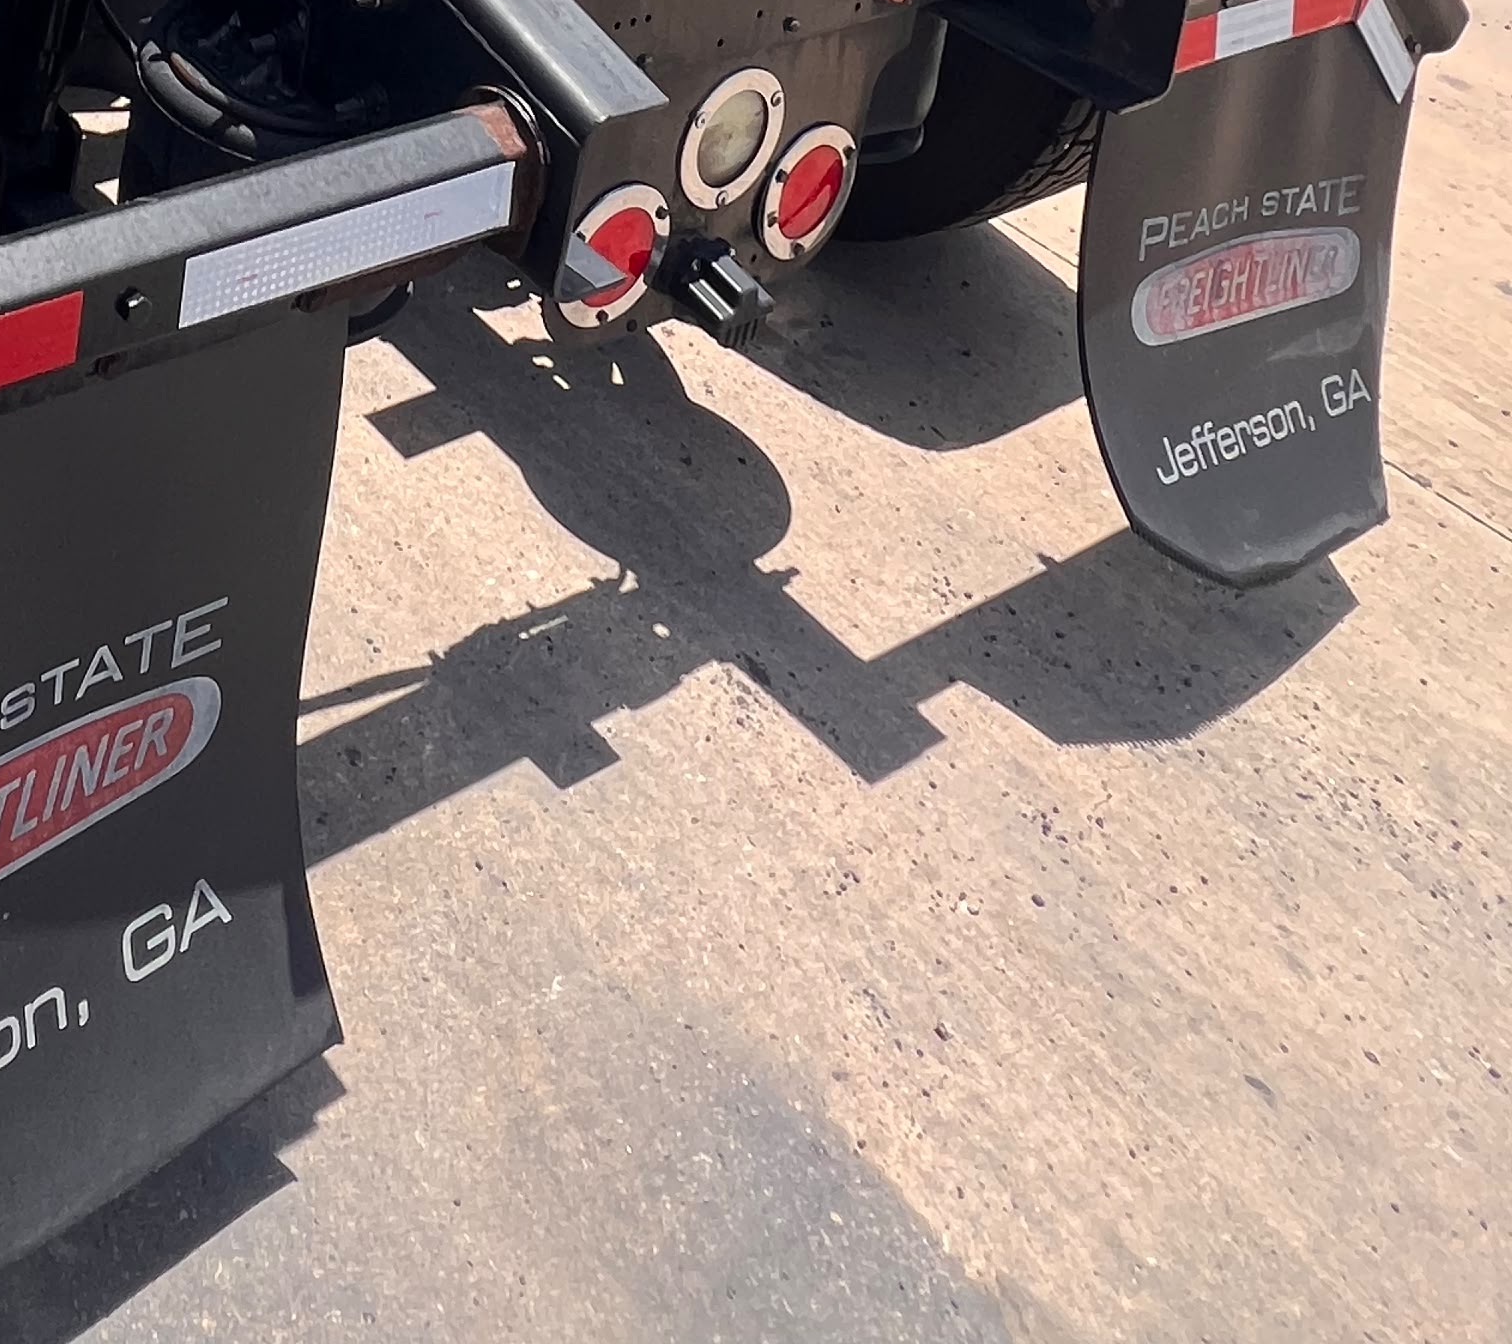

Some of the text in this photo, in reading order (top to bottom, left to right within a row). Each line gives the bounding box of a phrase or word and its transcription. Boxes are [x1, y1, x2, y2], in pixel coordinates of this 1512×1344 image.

[1138, 174, 1365, 261] PEACH STATE
[1156, 368, 1372, 485] Jefferson, GA
[121, 877, 233, 983] GA
